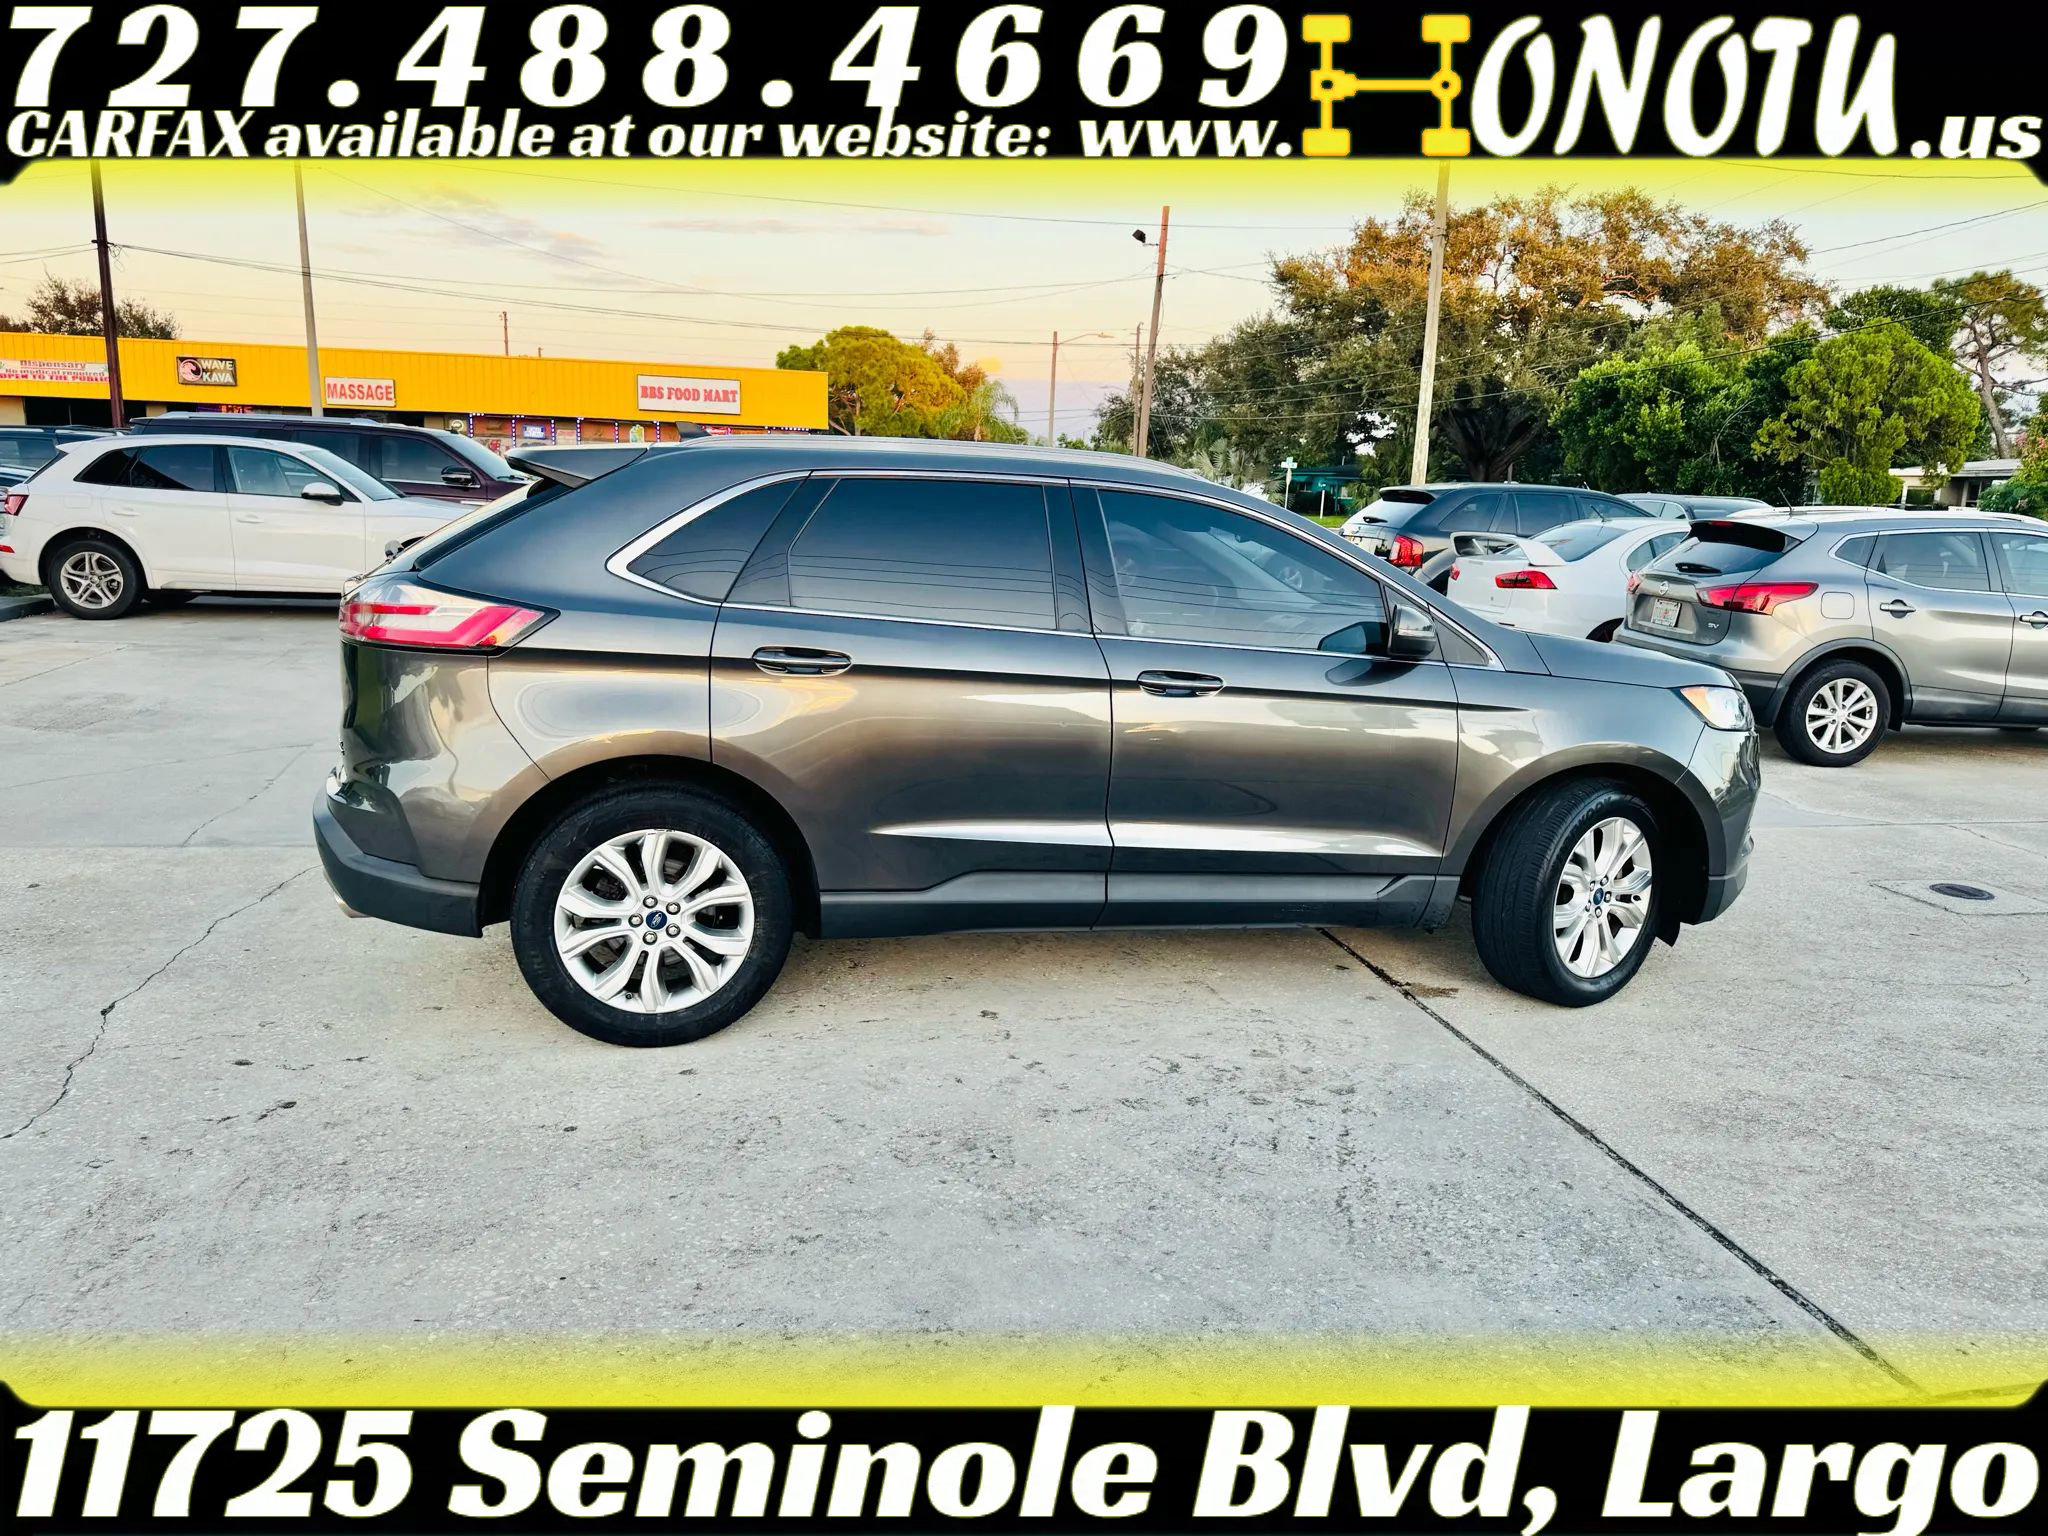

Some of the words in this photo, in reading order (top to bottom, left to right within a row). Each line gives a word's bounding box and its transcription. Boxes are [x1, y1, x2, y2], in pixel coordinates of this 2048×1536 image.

[20, 360, 86, 369] Dispensary
[200, 360, 233, 370] WAVE
[202, 371, 234, 383] KAVA
[327, 383, 393, 401] MASSAGE
[640, 385, 664, 399] BBS
[667, 387, 700, 401] FOOD
[703, 389, 738, 402] MART
